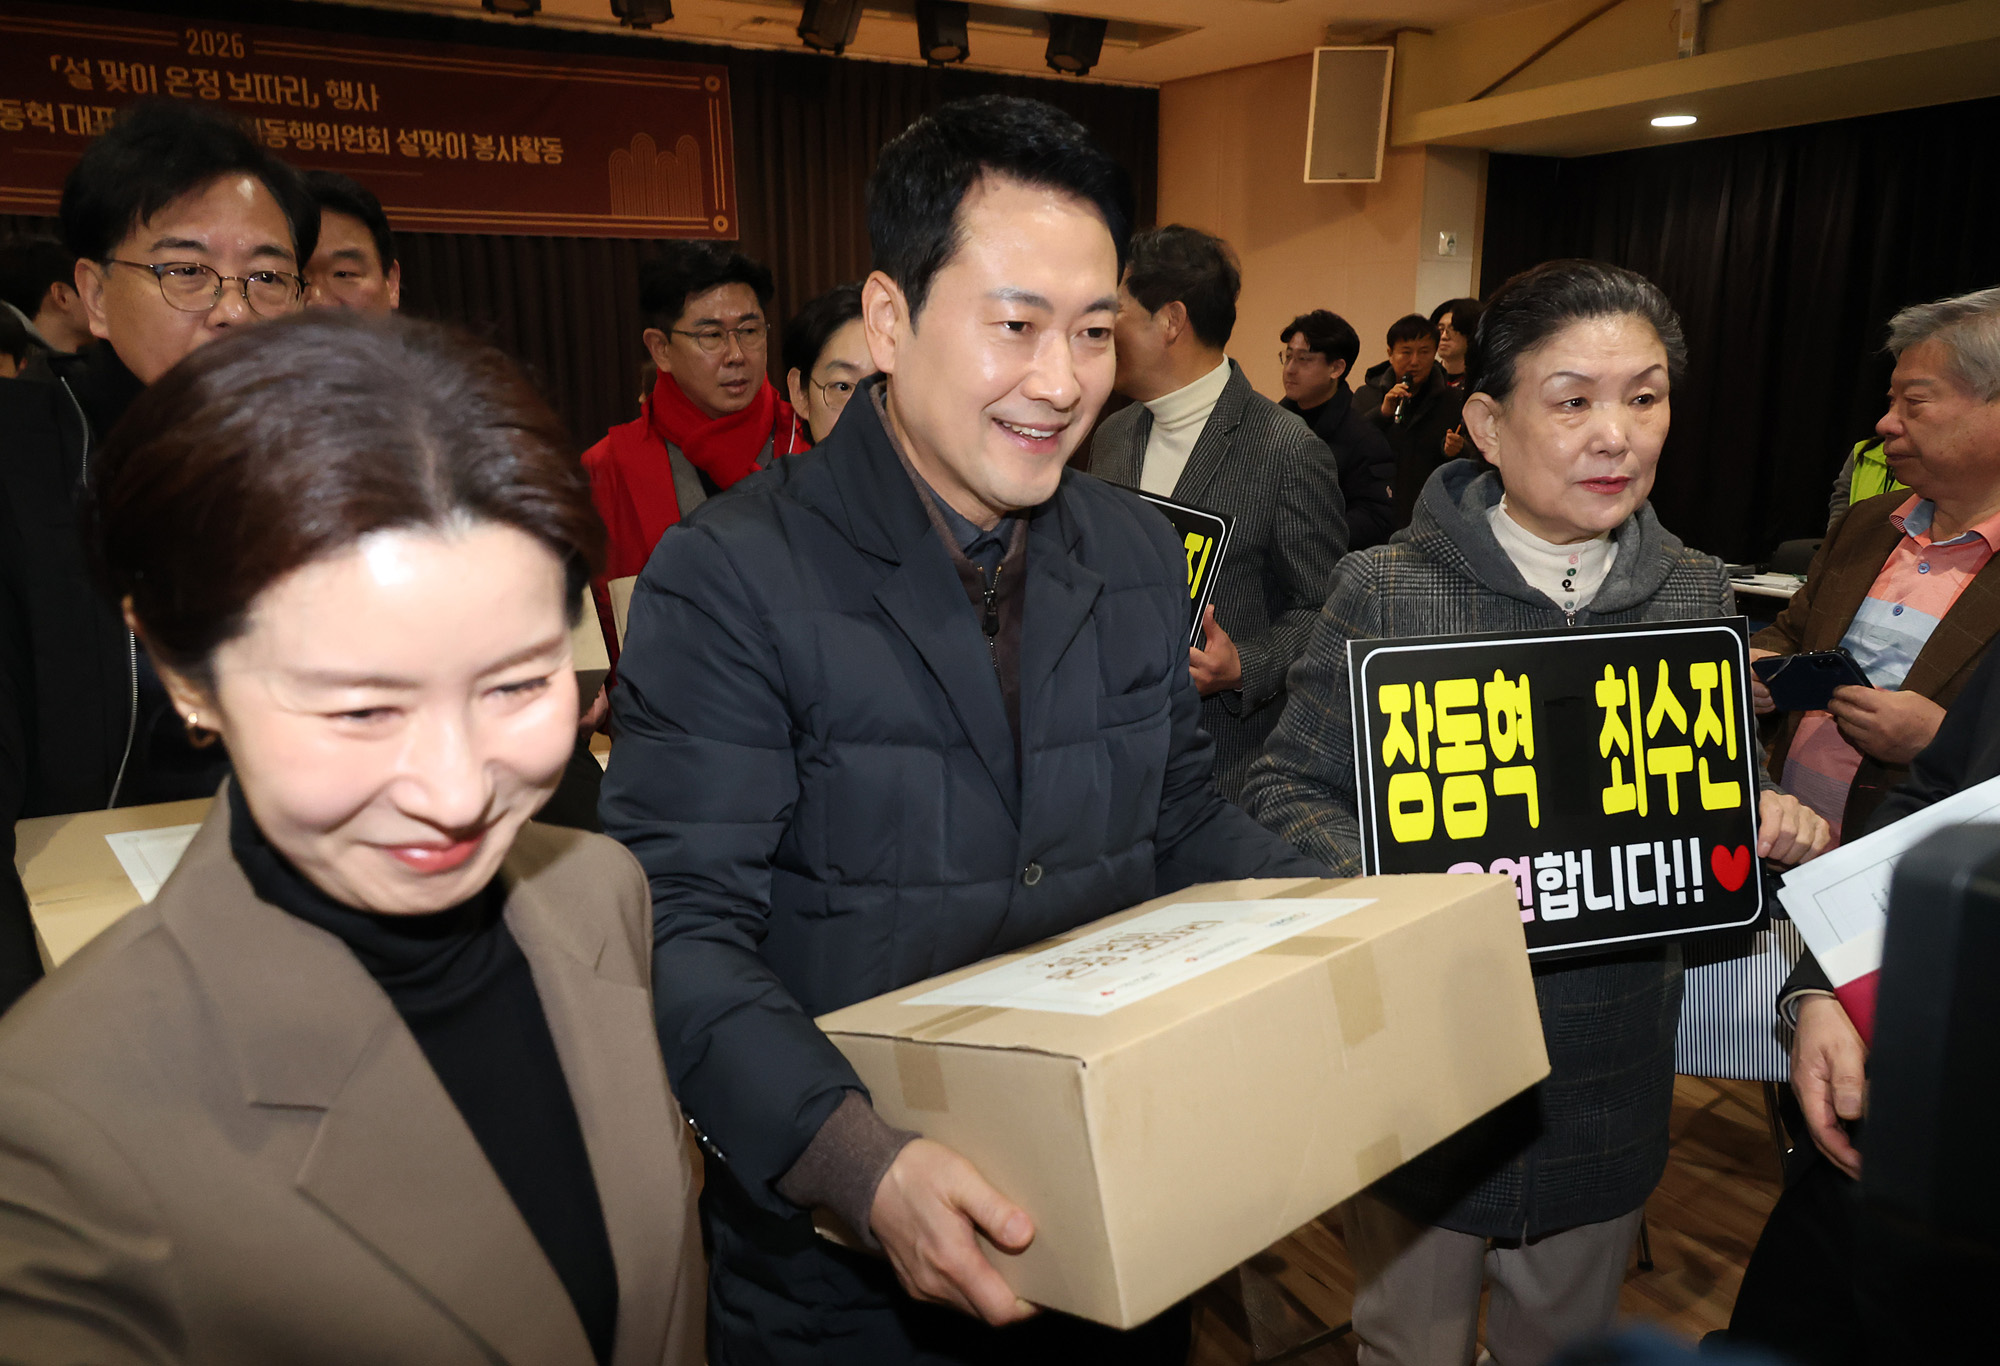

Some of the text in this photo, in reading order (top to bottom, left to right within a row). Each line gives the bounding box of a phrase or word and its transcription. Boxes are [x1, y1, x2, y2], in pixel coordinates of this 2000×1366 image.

[185, 28, 245, 59] 2026
[99, 59, 157, 95] 맞이
[164, 66, 220, 101] 온정
[324, 79, 379, 113] 행사
[396, 128, 467, 160] 설맞이
[471, 132, 564, 165] 봉사활동
[1378, 658, 1742, 843] 장동혁 최수진
[1446, 837, 1704, 922] 원합니다!!
